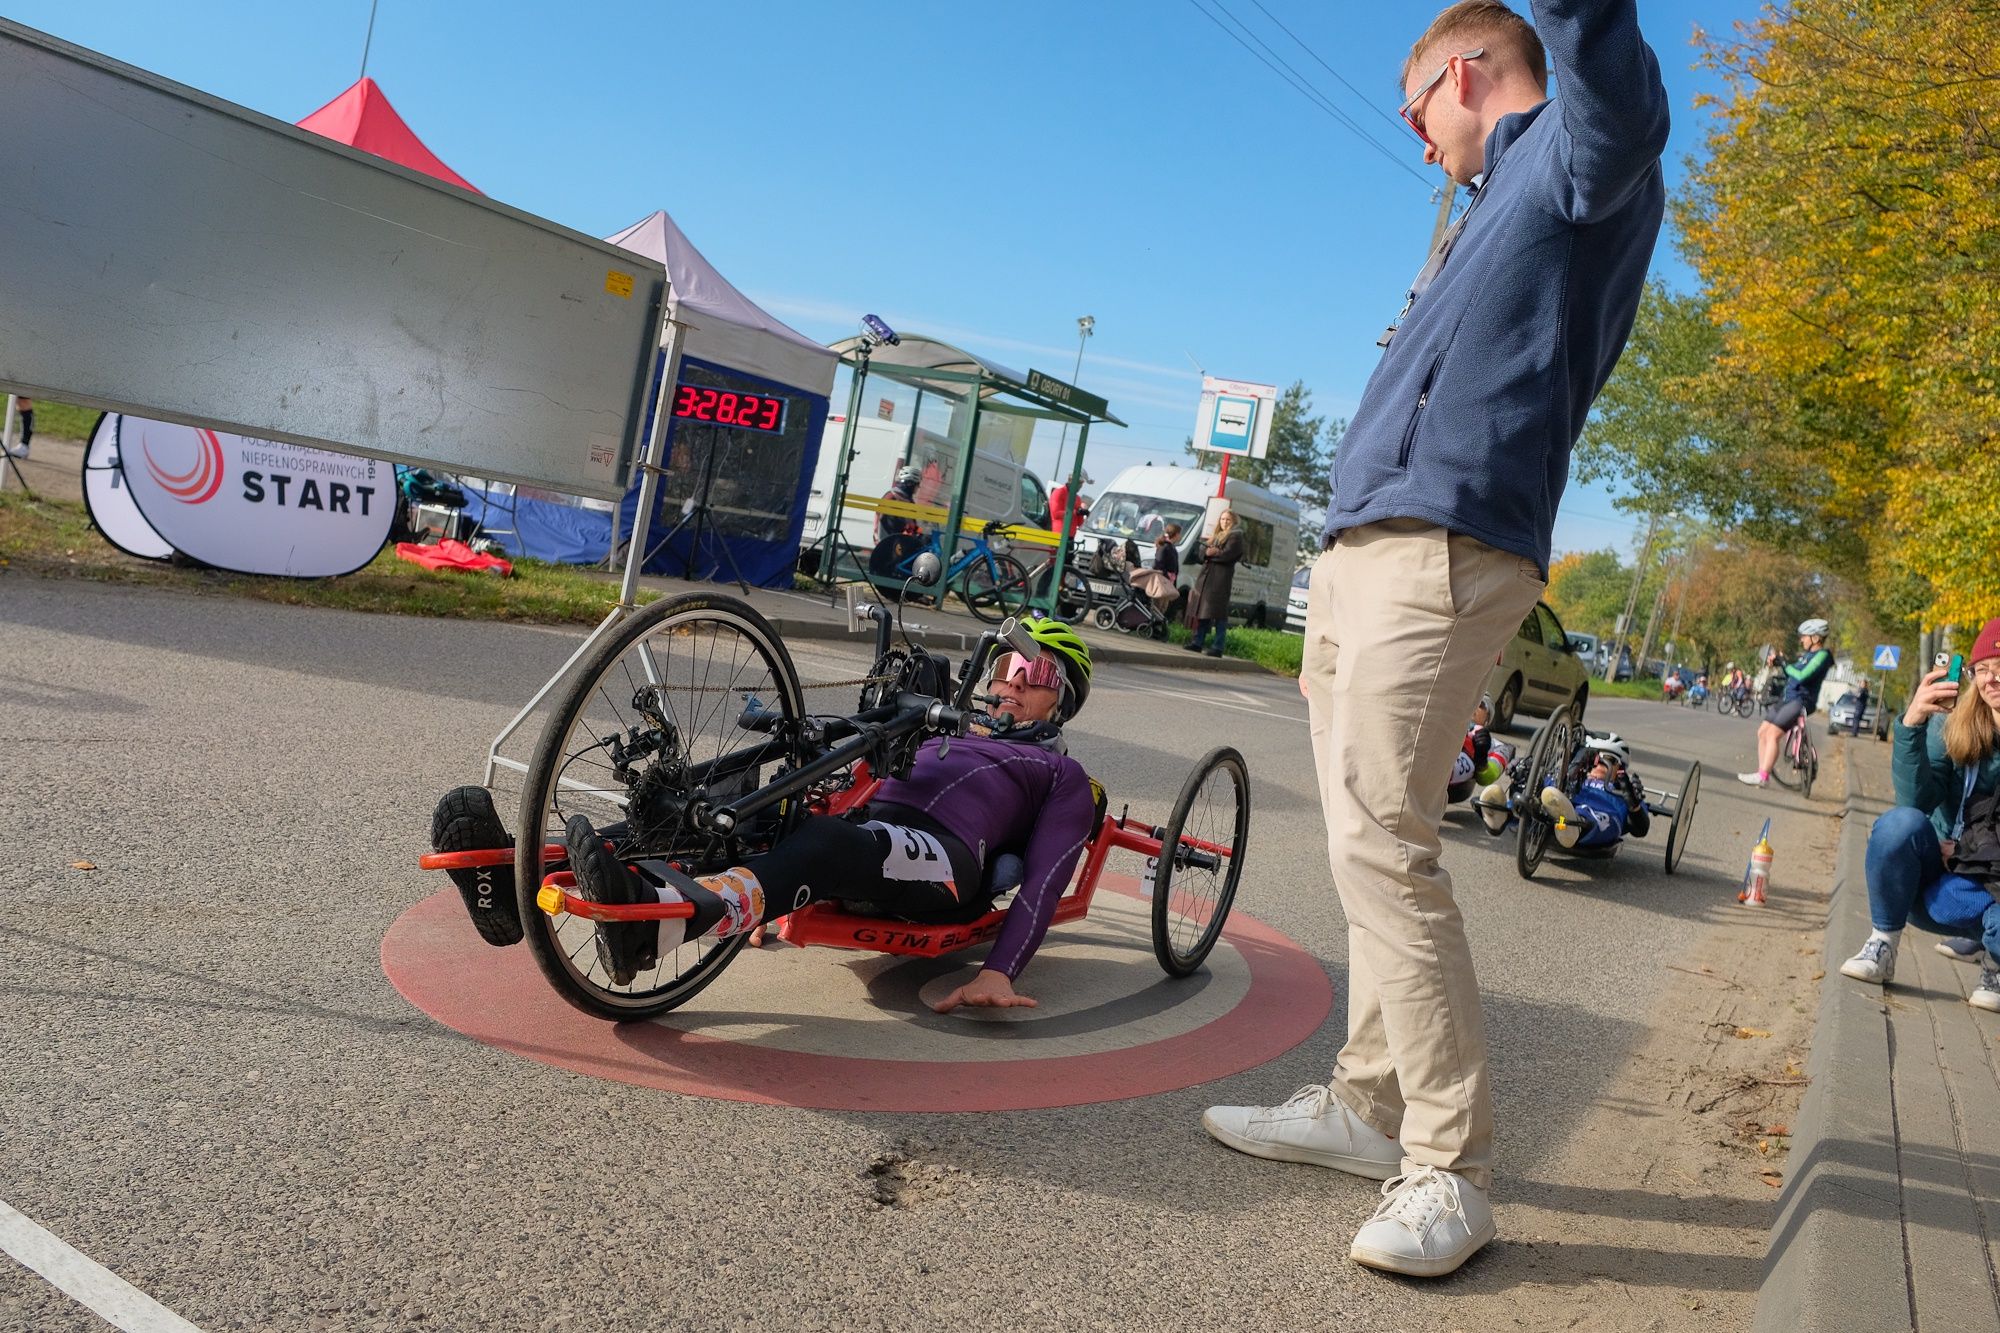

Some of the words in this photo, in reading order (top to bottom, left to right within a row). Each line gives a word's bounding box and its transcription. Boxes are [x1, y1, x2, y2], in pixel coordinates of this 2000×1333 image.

[241, 450, 366, 480] NIEPEŁNOSPRAWNYCH
[367, 457, 376, 480] 195
[242, 470, 375, 516] START
[1457, 756, 1471, 776] 33
[901, 826, 938, 861] 31
[476, 865, 493, 909] ROX
[852, 928, 933, 949] GTM
[940, 922, 1003, 949] BLAC
